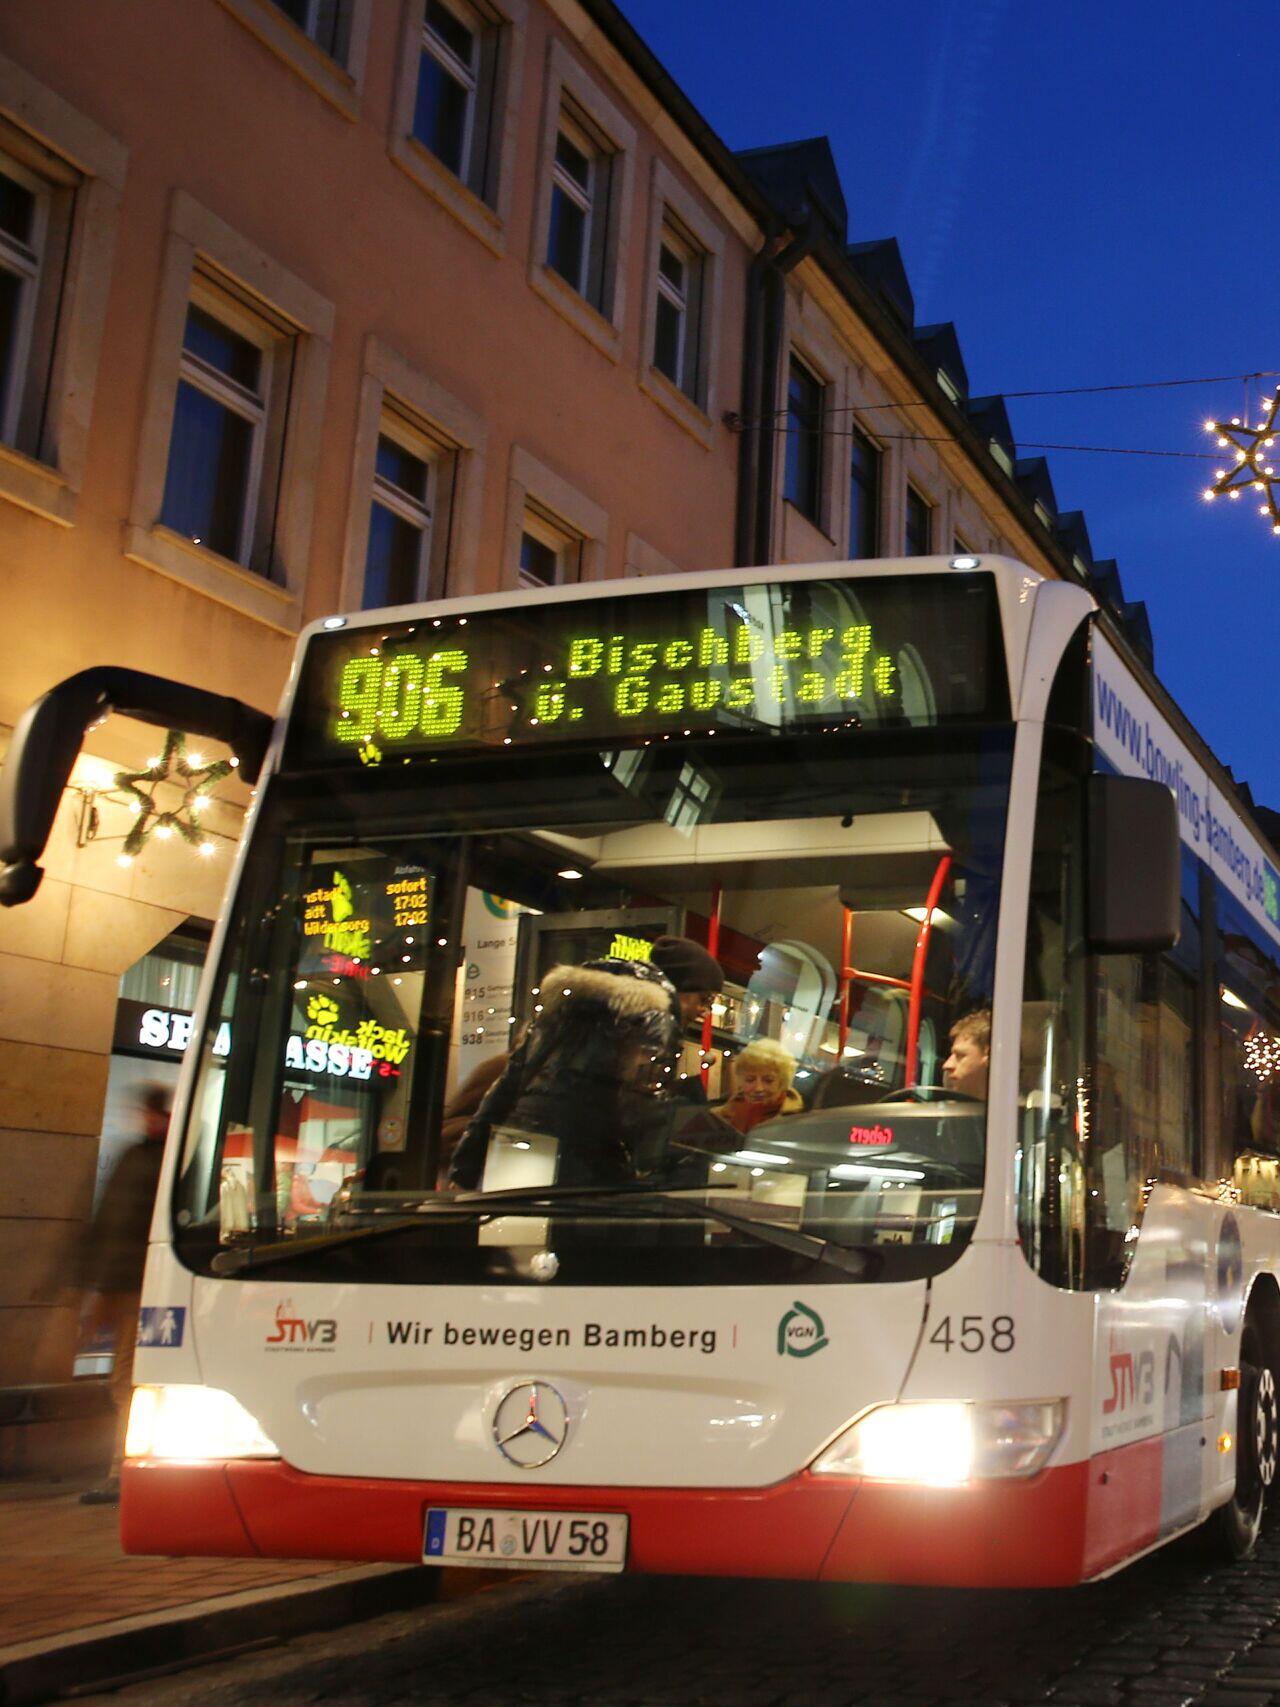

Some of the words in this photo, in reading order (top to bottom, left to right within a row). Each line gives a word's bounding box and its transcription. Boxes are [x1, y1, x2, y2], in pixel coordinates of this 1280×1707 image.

[570, 624, 872, 679] Bischberg
[335, 649, 468, 742] 906
[534, 682, 584, 723] ü.
[614, 652, 896, 718] Gaustadt
[385, 877, 427, 895] sofort
[477, 937, 506, 950] Lange
[387, 1321, 433, 1345] Wir
[444, 1323, 570, 1352] bewegen
[583, 1323, 717, 1354] Bamberg
[787, 1326, 815, 1339] VGN
[929, 1315, 1016, 1353] 458
[456, 1516, 495, 1552] BA
[522, 1518, 563, 1554] VV
[568, 1520, 609, 1557] 58
